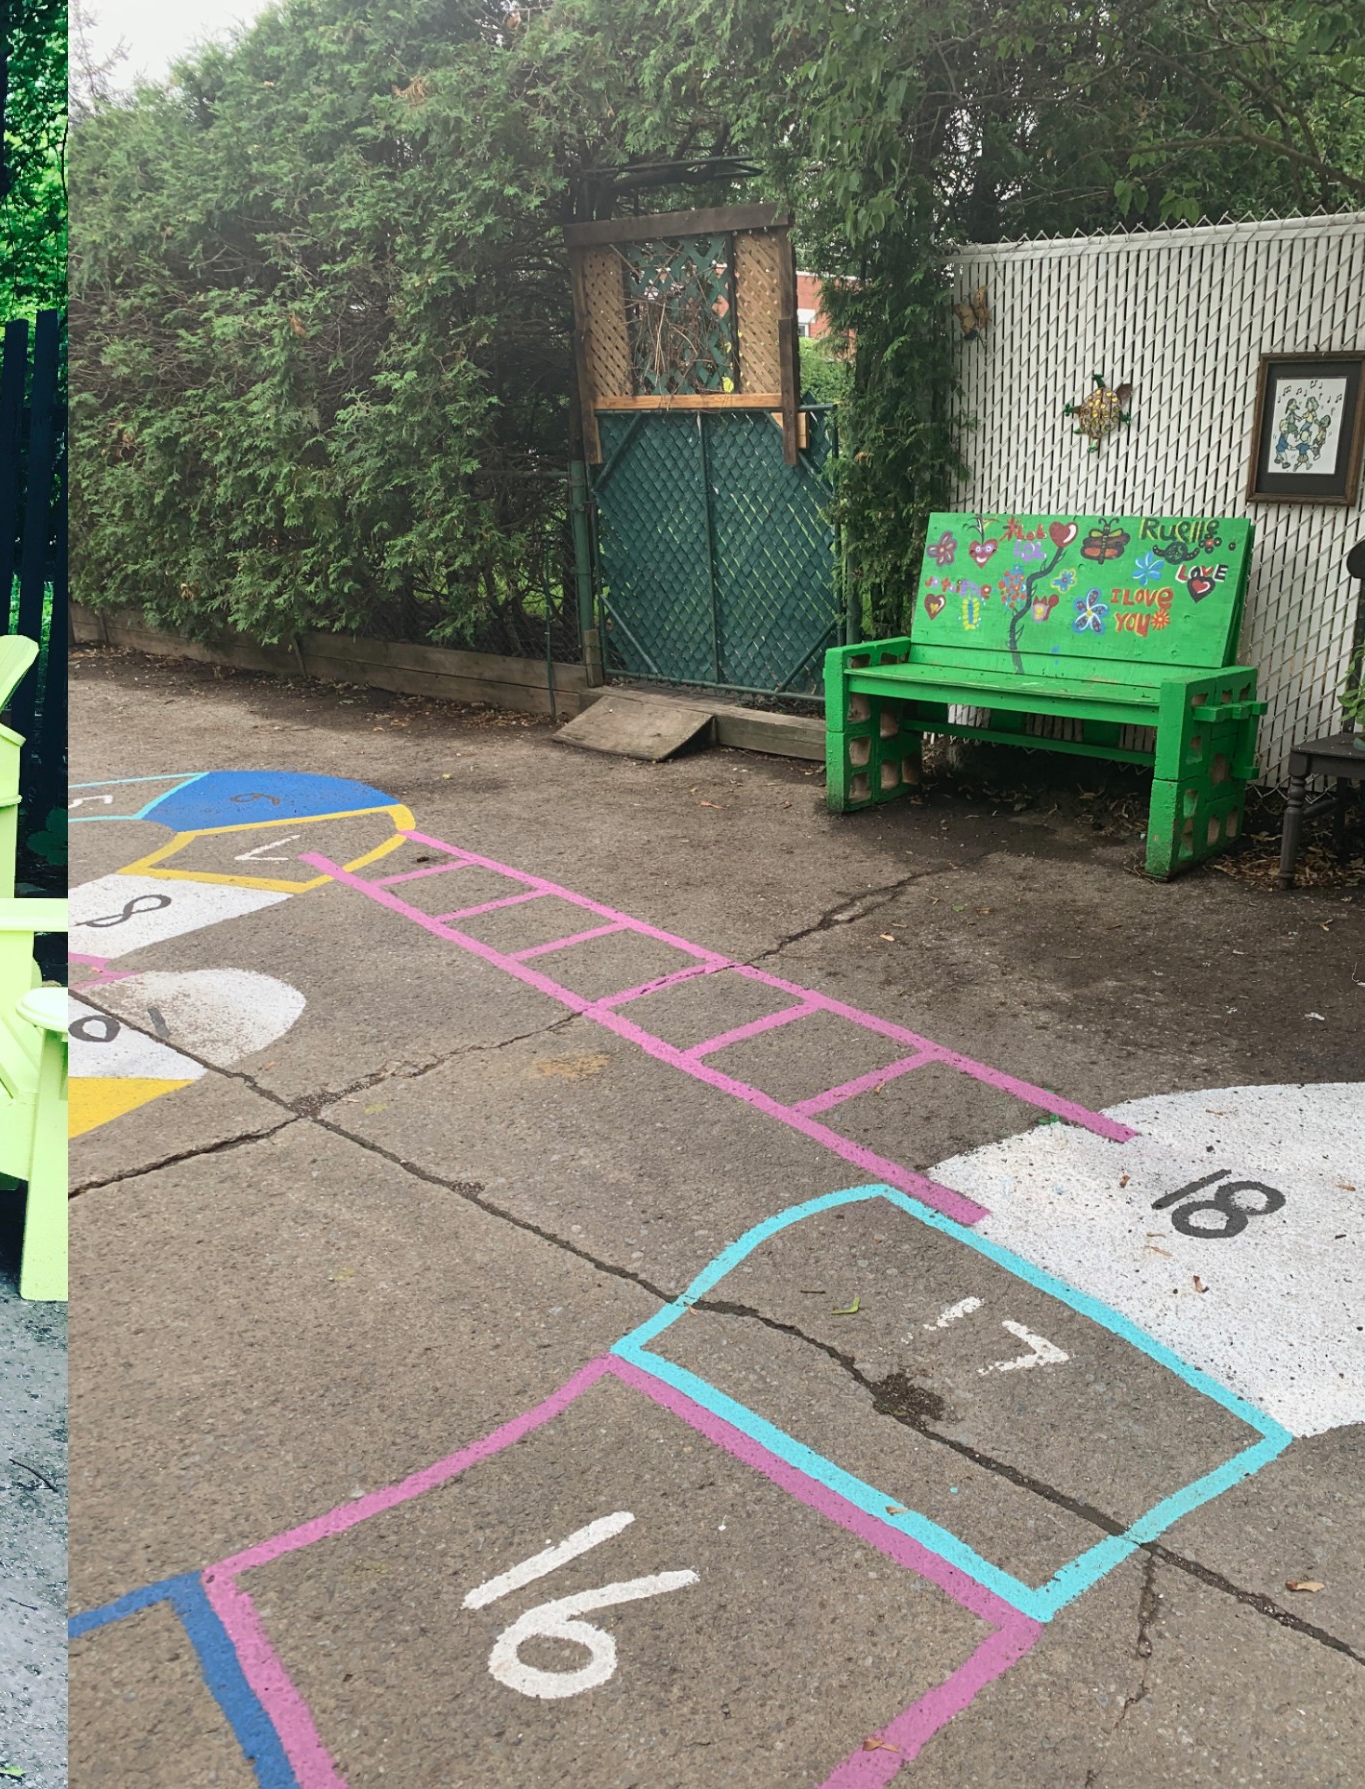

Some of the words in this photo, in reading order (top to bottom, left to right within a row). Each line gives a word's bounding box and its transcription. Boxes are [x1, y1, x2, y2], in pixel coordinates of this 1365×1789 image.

[1139, 517, 1220, 544] Ruelle
[1175, 564, 1229, 583] LOVE
[1110, 588, 1123, 604] I
[1114, 612, 1151, 638] YOU
[1151, 1168, 1287, 1240] 18
[899, 1296, 1073, 1379] 17
[463, 1510, 700, 1700] 16
